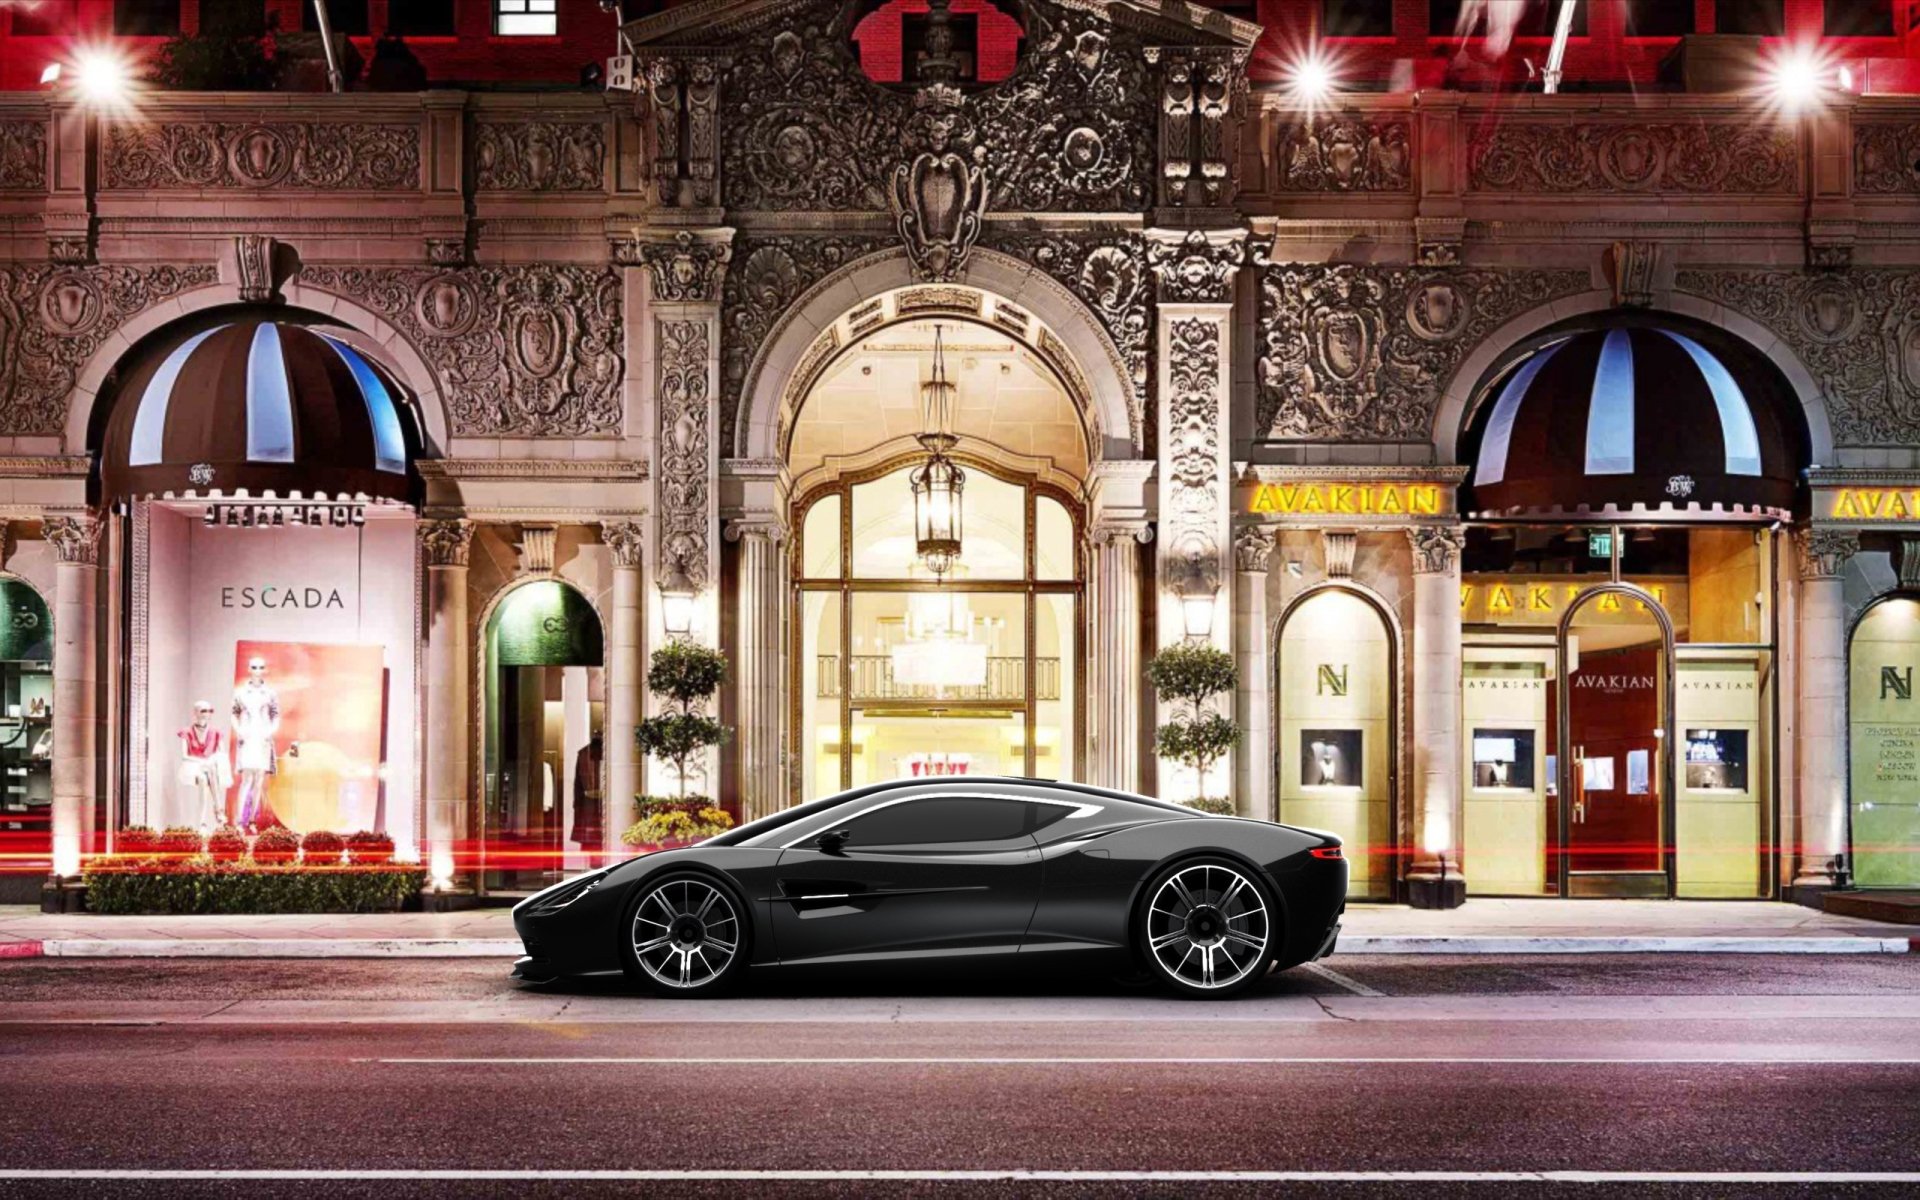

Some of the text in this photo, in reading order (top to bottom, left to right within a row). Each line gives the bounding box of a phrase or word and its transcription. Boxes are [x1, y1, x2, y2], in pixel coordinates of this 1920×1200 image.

[1255, 486, 1438, 511] AVAKIAN
[1836, 490, 1920, 517] AVA
[221, 587, 344, 608] ESCADA
[1468, 681, 1541, 689] AVAKIAN
[1575, 675, 1654, 689] AVAKIAN
[1681, 681, 1753, 690] AVAKIAN
